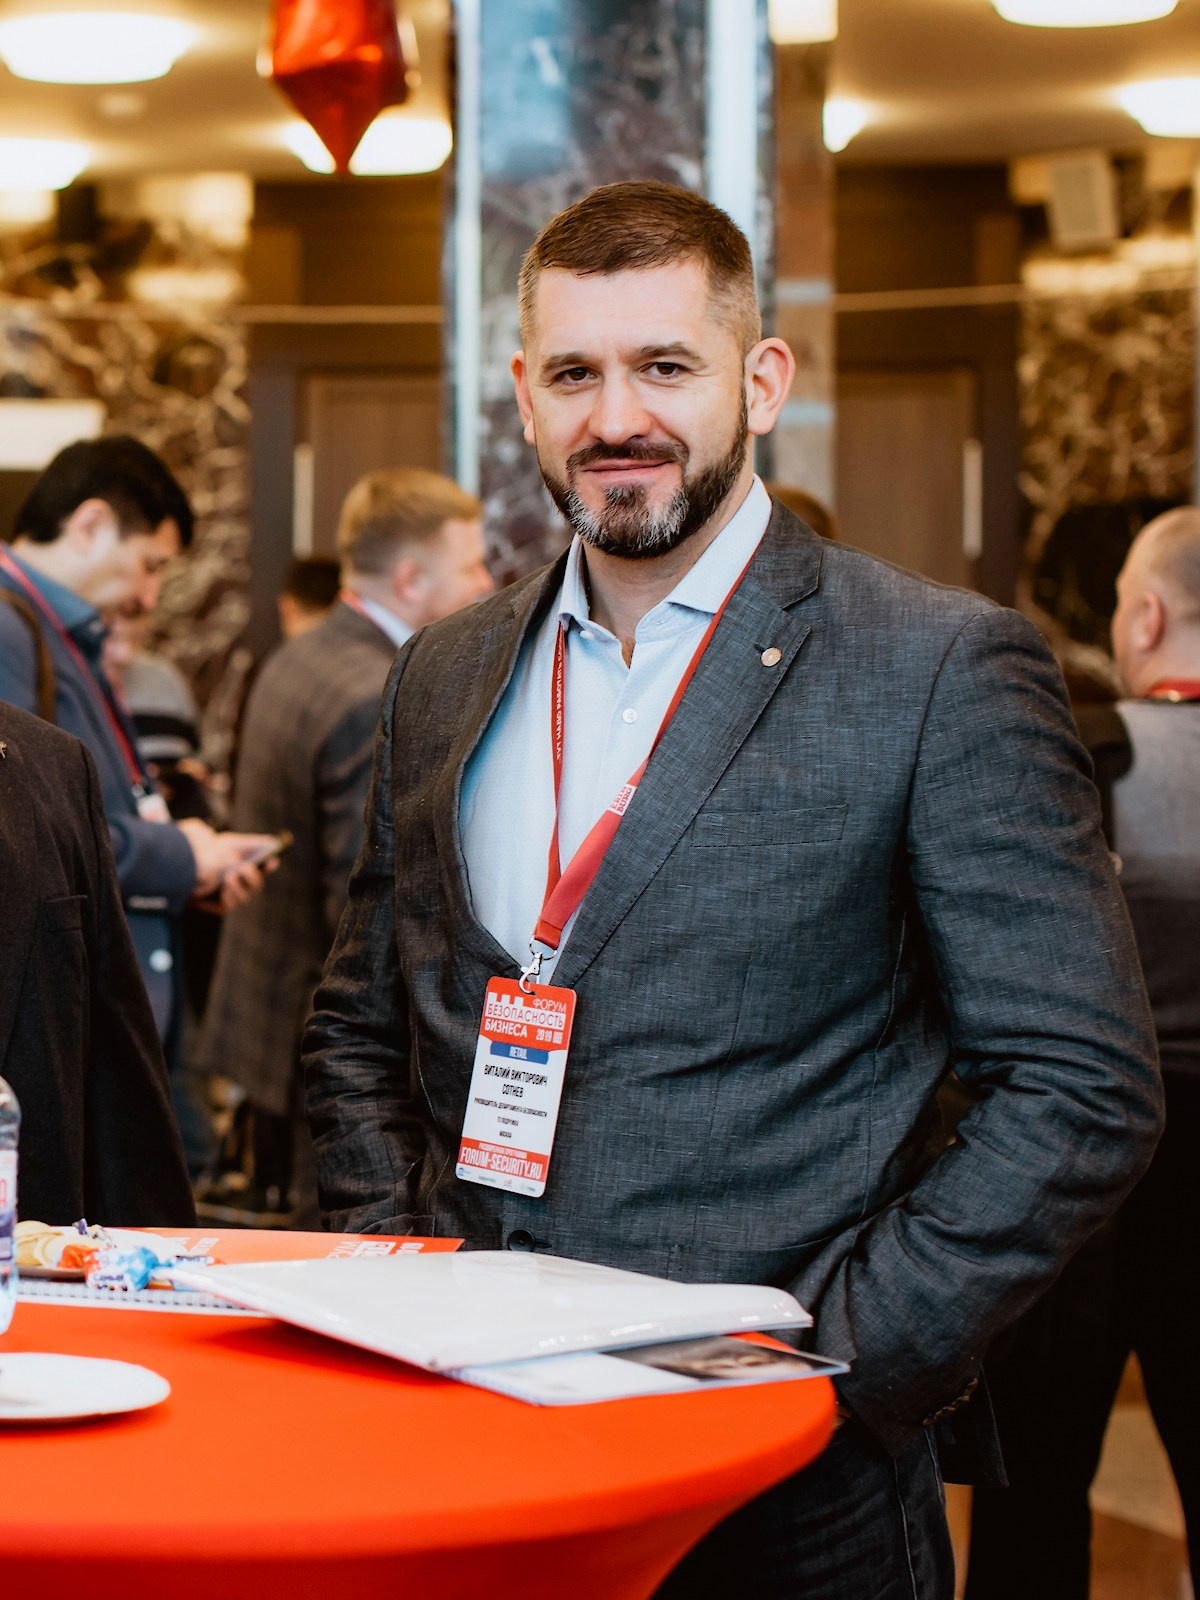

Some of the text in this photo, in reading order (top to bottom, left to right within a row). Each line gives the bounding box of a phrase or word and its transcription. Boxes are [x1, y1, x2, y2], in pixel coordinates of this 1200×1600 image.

[617, 787, 633, 812] BURG
[487, 1003, 564, 1028] БЕЗОПАСНОСТЬ
[533, 998, 567, 1014] ФОРУМ
[484, 1018, 553, 1043] БИЗНЕСА 2019
[484, 1064, 548, 1087] ВИТАЛИЙ ВИКТОРОВИЧ
[460, 1147, 543, 1180] FORUM-SECURITY.RU
